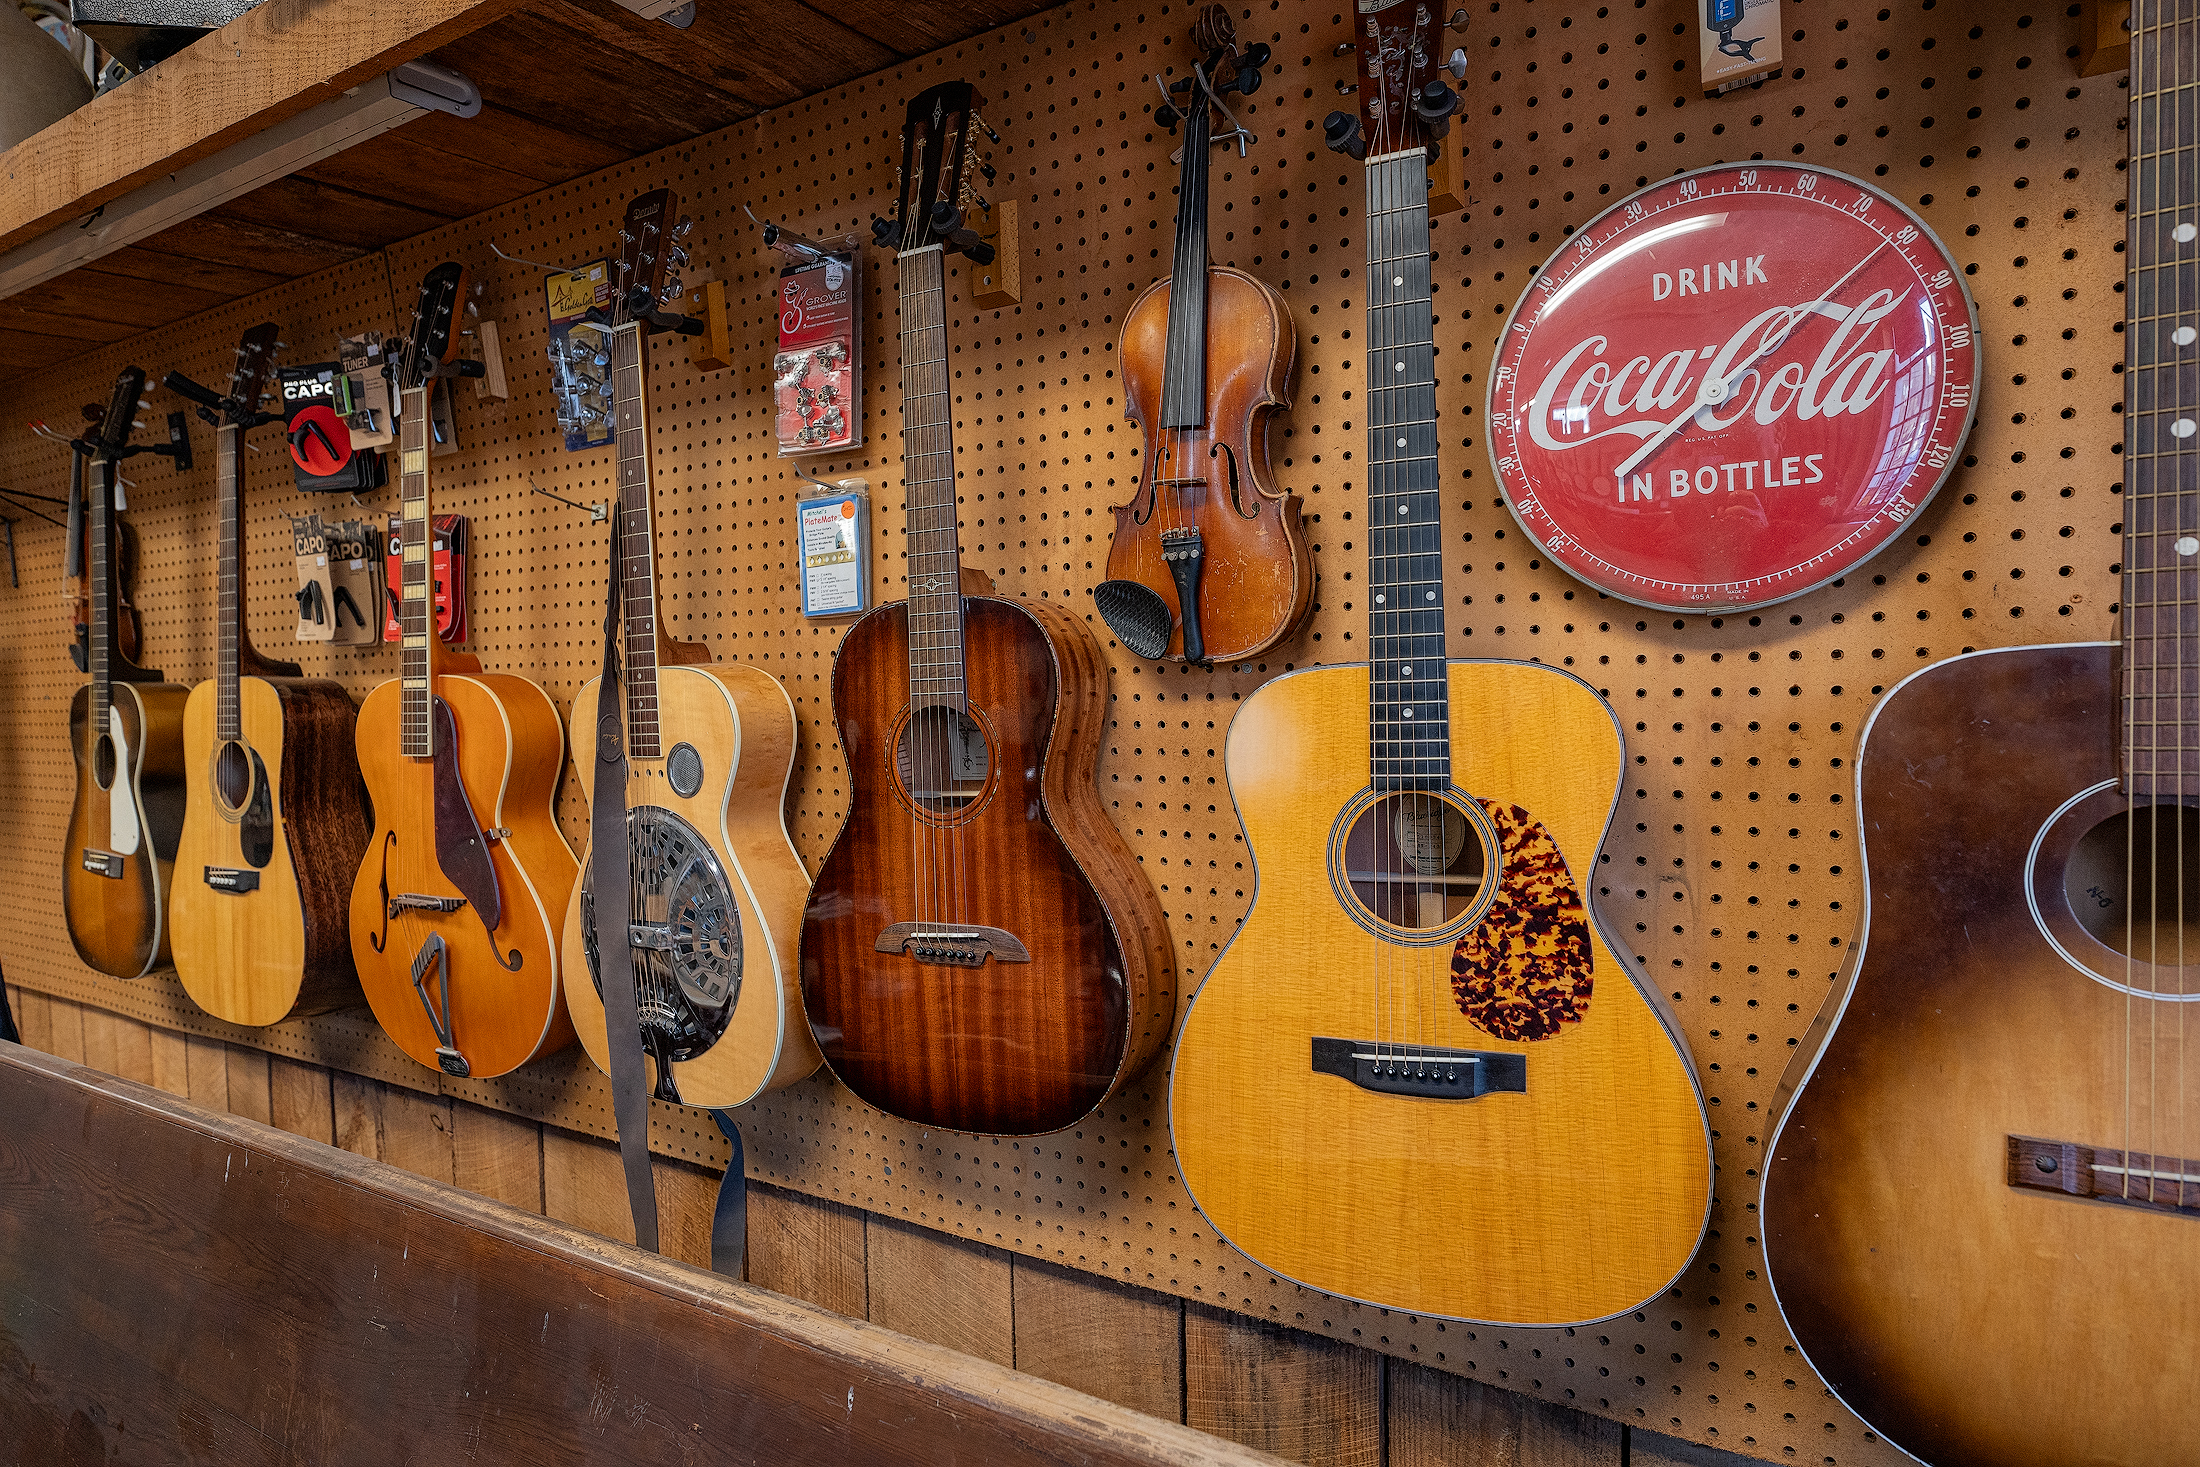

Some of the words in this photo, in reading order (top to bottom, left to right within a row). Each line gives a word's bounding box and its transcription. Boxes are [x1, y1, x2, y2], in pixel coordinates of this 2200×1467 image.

[1680, 179, 1697, 196] 40
[1738, 170, 1757, 187] 50
[1797, 174, 1817, 191] 60
[1624, 201, 1643, 219] 30
[1852, 193, 1874, 213] 70
[1575, 235, 1593, 254] 20
[1896, 225, 1919, 245] 80
[1536, 275, 1554, 293] 10
[1652, 255, 1768, 301] DRINK
[1931, 269, 1953, 289] 90
[806, 291, 846, 306] GROVER
[1512, 322, 1526, 333] 0
[1949, 323, 1970, 349] 100
[343, 356, 369, 373] TUNER
[1529, 281, 1915, 450] Coca-Cola
[1949, 384, 1970, 408] 110
[1492, 412, 1507, 435] -20
[1927, 443, 1952, 469] 120
[1498, 456, 1515, 477] -30
[1618, 472, 1654, 503] IN
[1669, 453, 1824, 498] BOTTLES
[1517, 499, 1535, 520] -40
[1888, 494, 1915, 523] 130
[804, 515, 838, 526] PlateMate
[296, 535, 324, 556] CAPO
[330, 541, 363, 560] APO
[1546, 536, 1565, 553] -50
